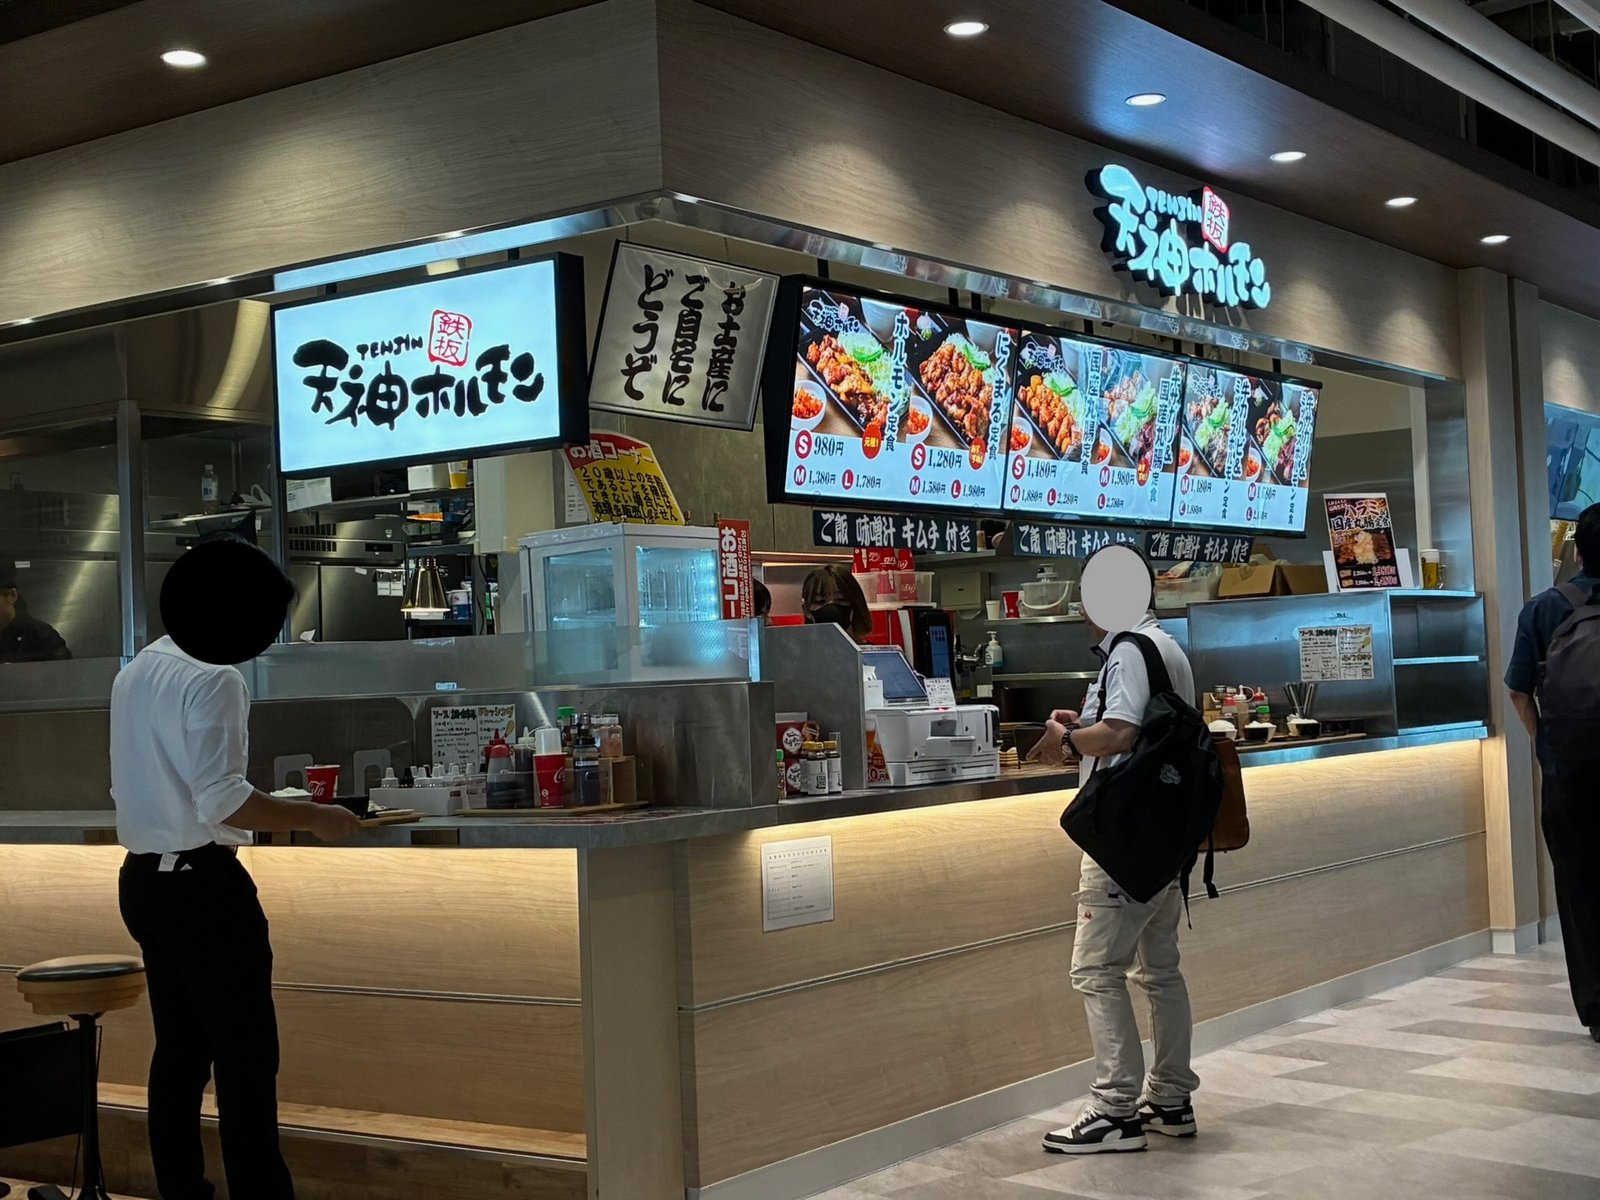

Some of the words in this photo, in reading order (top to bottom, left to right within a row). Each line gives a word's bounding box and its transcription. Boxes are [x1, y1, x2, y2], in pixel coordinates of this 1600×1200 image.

[1146, 186, 1202, 223] TENJIN
[1100, 164, 1271, 309] 天神ホルモン
[356, 334, 424, 361] TENJIN
[434, 312, 466, 364] 鉄板
[621, 264, 674, 401] どうぞ
[662, 274, 710, 406] ご自宅に
[702, 281, 747, 412] お土産に
[292, 339, 545, 431] 天神ホルモン
[886, 312, 909, 451] ホルモン定食
[988, 331, 1010, 459] にくまる定食
[798, 436, 807, 454] S
[814, 436, 844, 456] 980円
[928, 449, 963, 470] 1,280円
[808, 470, 836, 485] 1,380円
[855, 474, 881, 489] 1,780円
[922, 480, 946, 495] 1,580円
[1027, 460, 1057, 478] 1,480円
[1111, 470, 1135, 486] 1,980円
[820, 512, 849, 545] ご飯
[855, 514, 896, 548] 味噌汁
[902, 516, 940, 550] キムチ
[946, 520, 972, 553] 付き
[1019, 525, 1041, 555] ご飯
[1045, 527, 1077, 557] 味噌汁
[1150, 533, 1168, 558] ご飯
[1172, 534, 1200, 561] 味噌汁
[1204, 537, 1228, 563] キムチ
[1230, 538, 1249, 564] 付き
